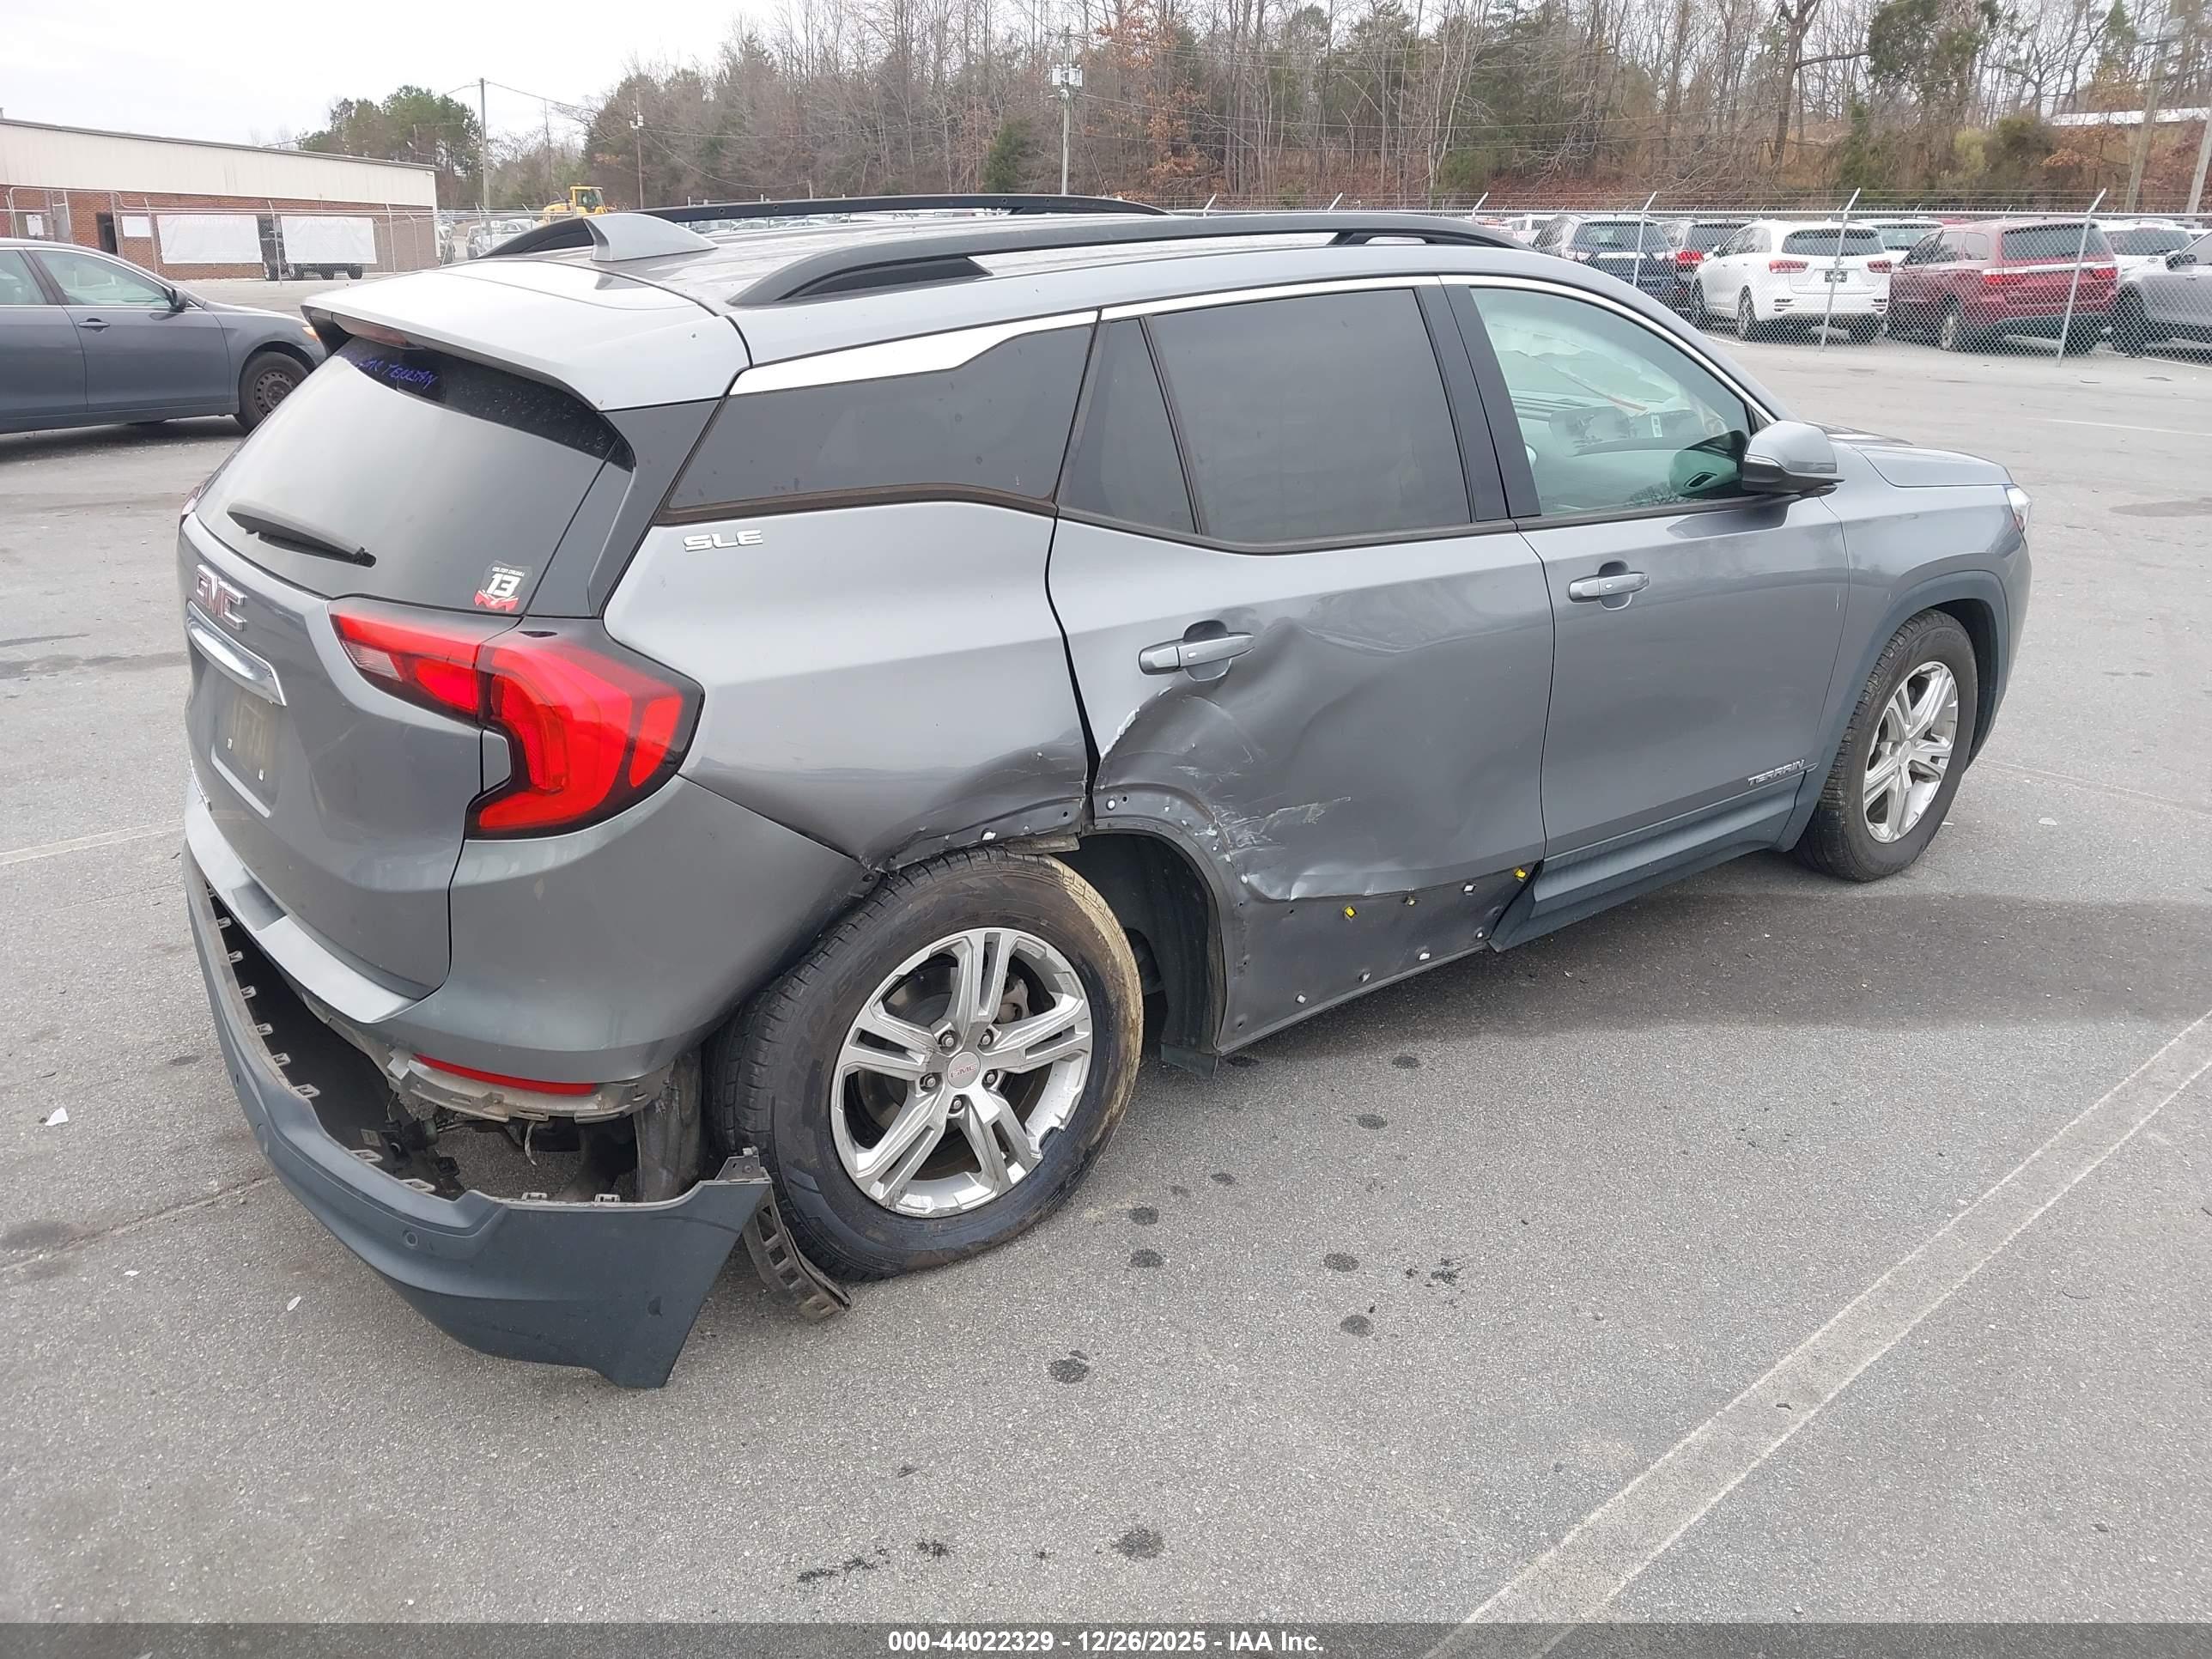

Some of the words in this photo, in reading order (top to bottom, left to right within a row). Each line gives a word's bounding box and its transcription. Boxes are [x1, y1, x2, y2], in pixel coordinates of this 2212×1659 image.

[683, 530, 763, 552] SLE
[194, 564, 247, 632] GMC
[486, 573, 521, 598] 13
[1747, 758, 1805, 787] TERRAIN
[950, 1064, 977, 1079] GMC
